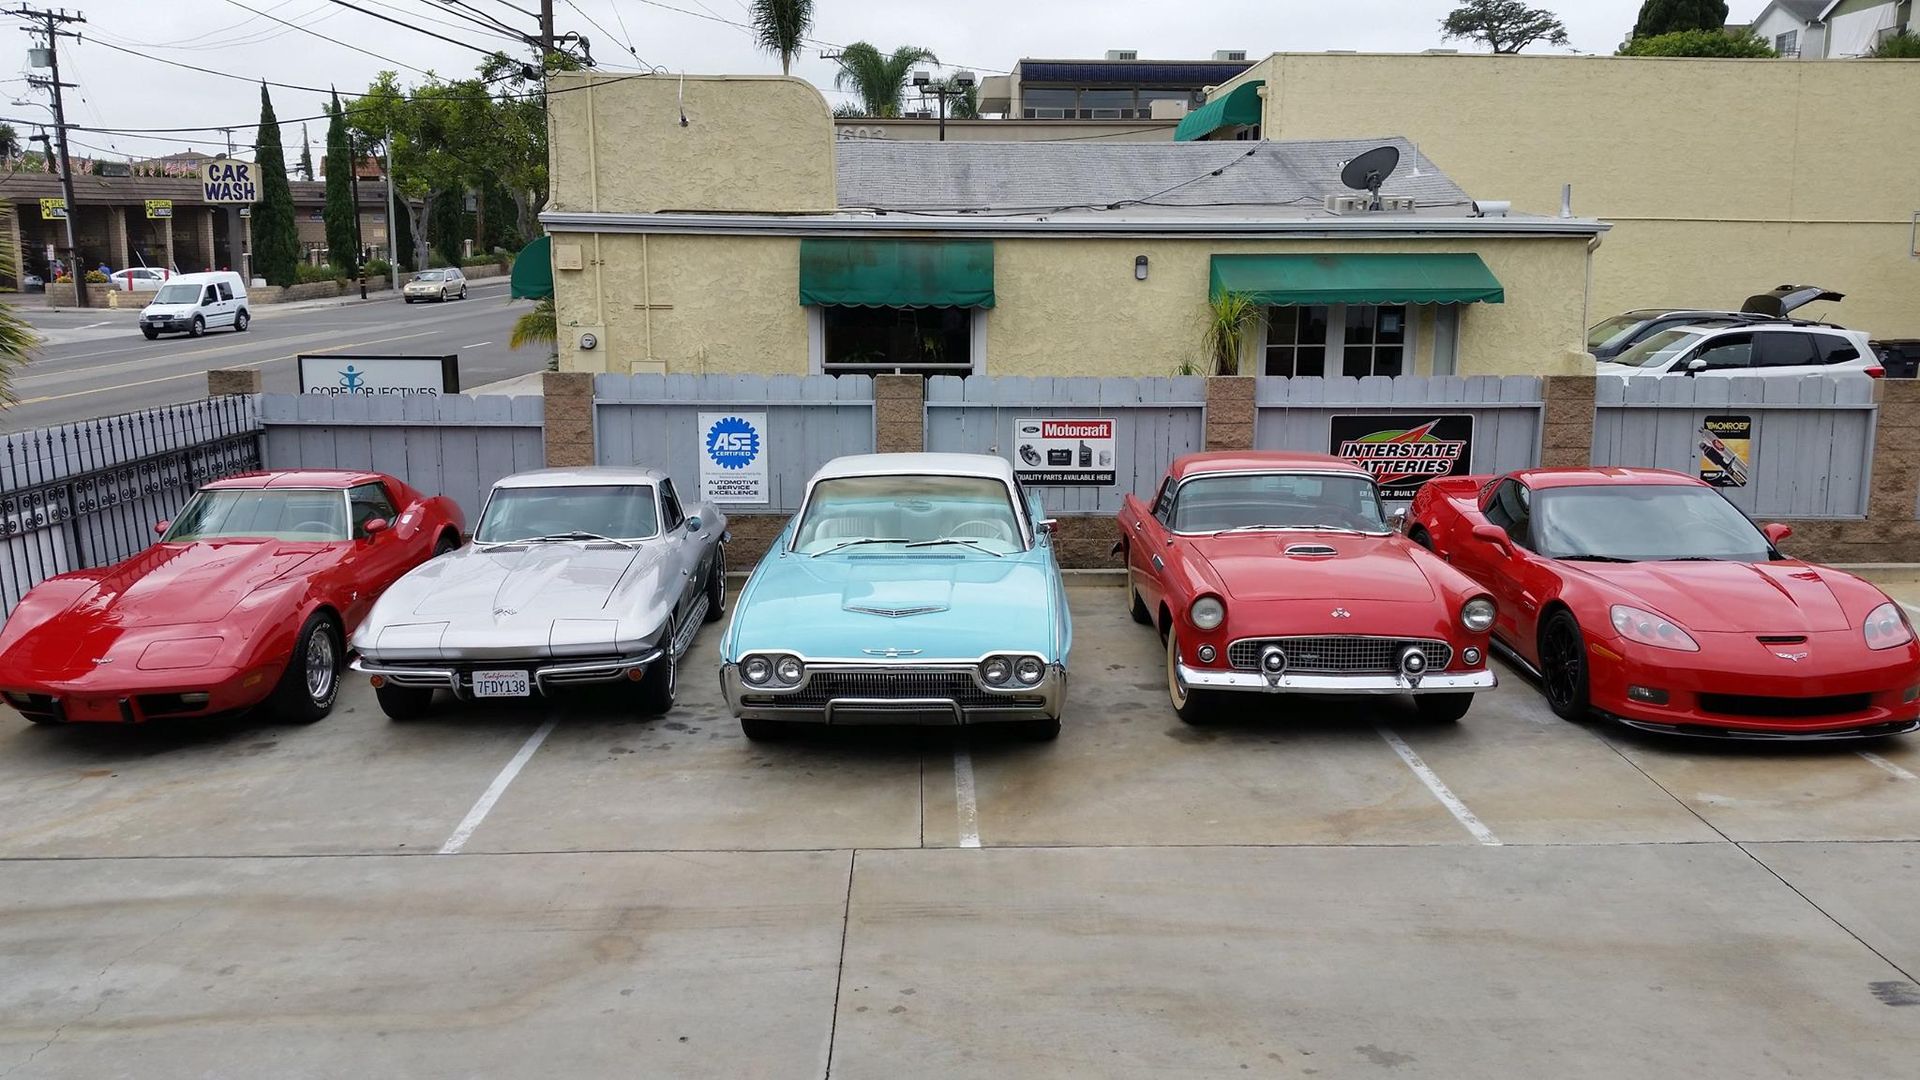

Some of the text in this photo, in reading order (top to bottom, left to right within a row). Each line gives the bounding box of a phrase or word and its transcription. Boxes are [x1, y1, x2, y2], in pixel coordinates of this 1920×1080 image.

[208, 164, 250, 182] CAR
[204, 182, 256, 201] WASH
[1044, 423, 1110, 437] Motorcraft
[1712, 422, 1744, 430] MONROE
[713, 432, 752, 451] ASE
[1341, 442, 1460, 459] INTERSTATE
[1042, 473, 1062, 481] PARTS
[1063, 473, 1095, 481] AVAILABLE
[1096, 473, 1112, 481] HERE
[476, 680, 526, 693] 7FDY138
